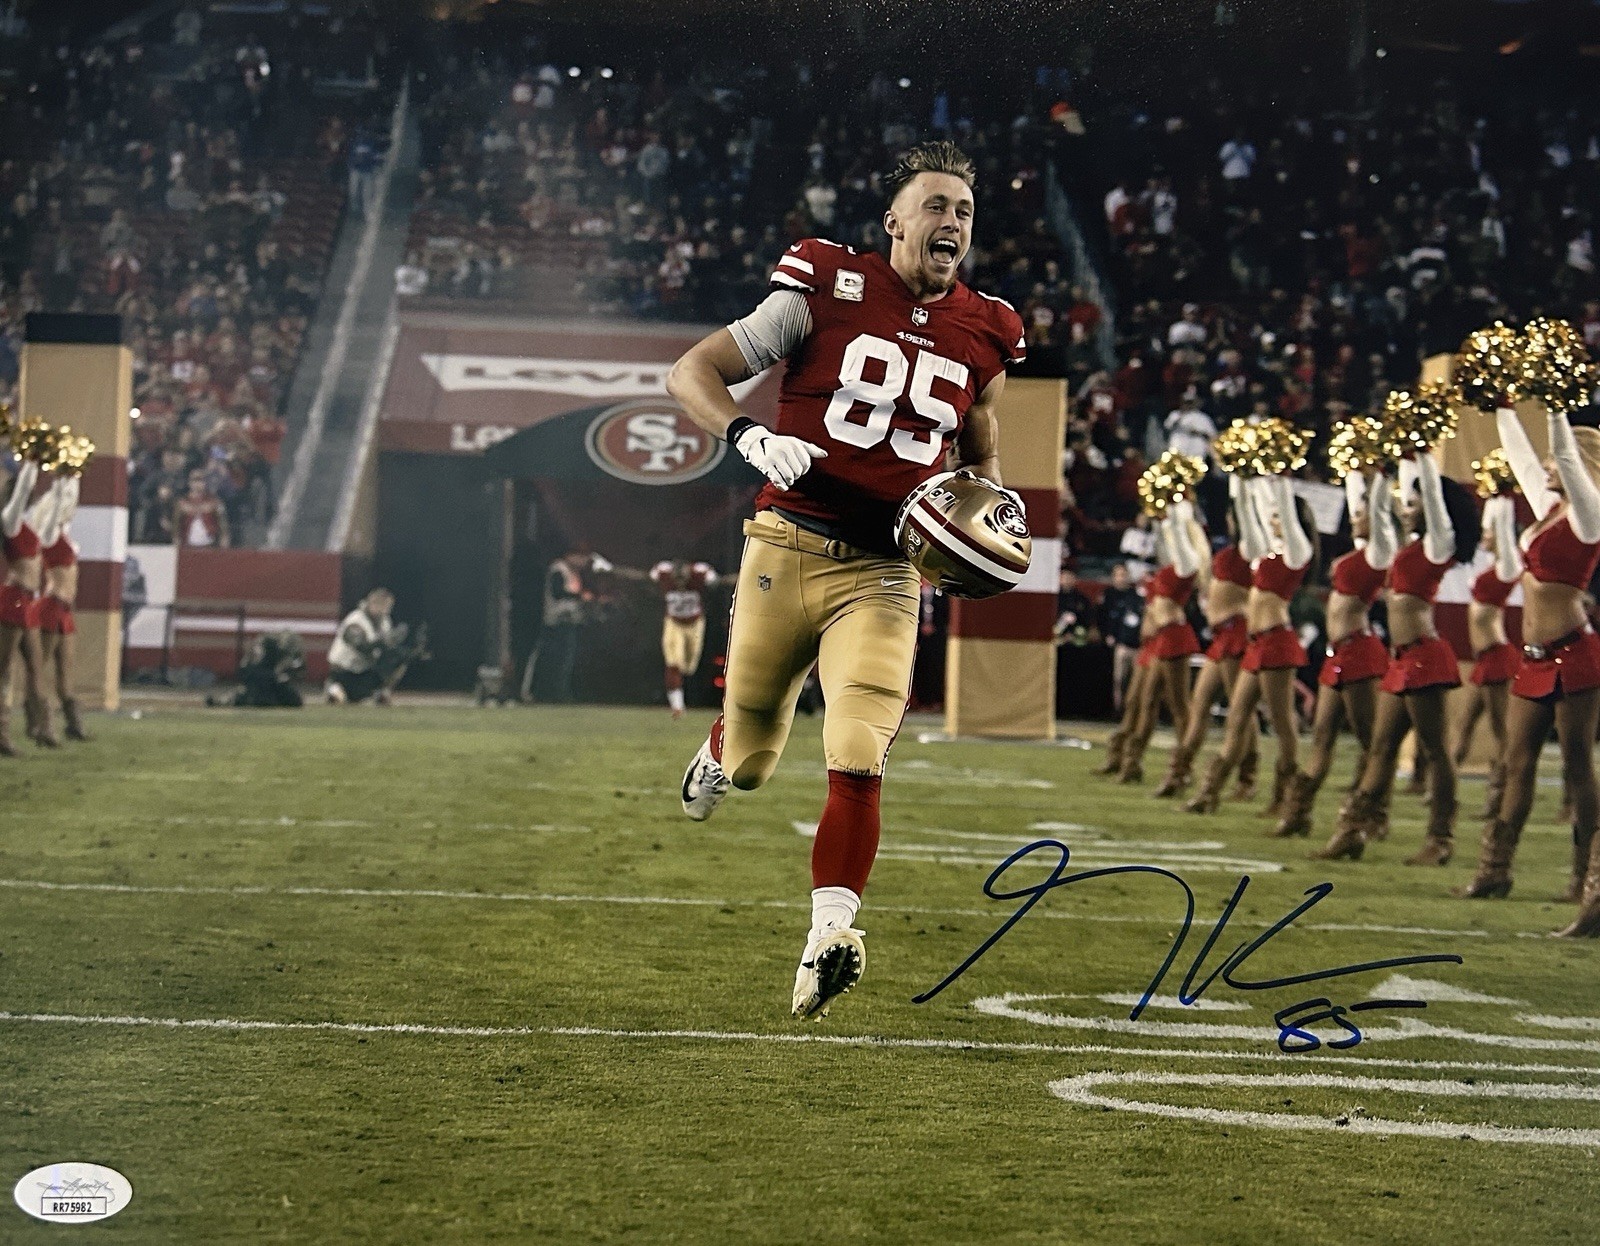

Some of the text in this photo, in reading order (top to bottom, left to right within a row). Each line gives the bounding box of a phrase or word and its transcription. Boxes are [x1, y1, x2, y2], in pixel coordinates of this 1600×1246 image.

[896, 331, 935, 348] 49ERS
[462, 364, 660, 387] LEVI
[824, 333, 969, 466] 85
[626, 413, 700, 472] SF
[53, 1202, 92, 1213] RR75982
